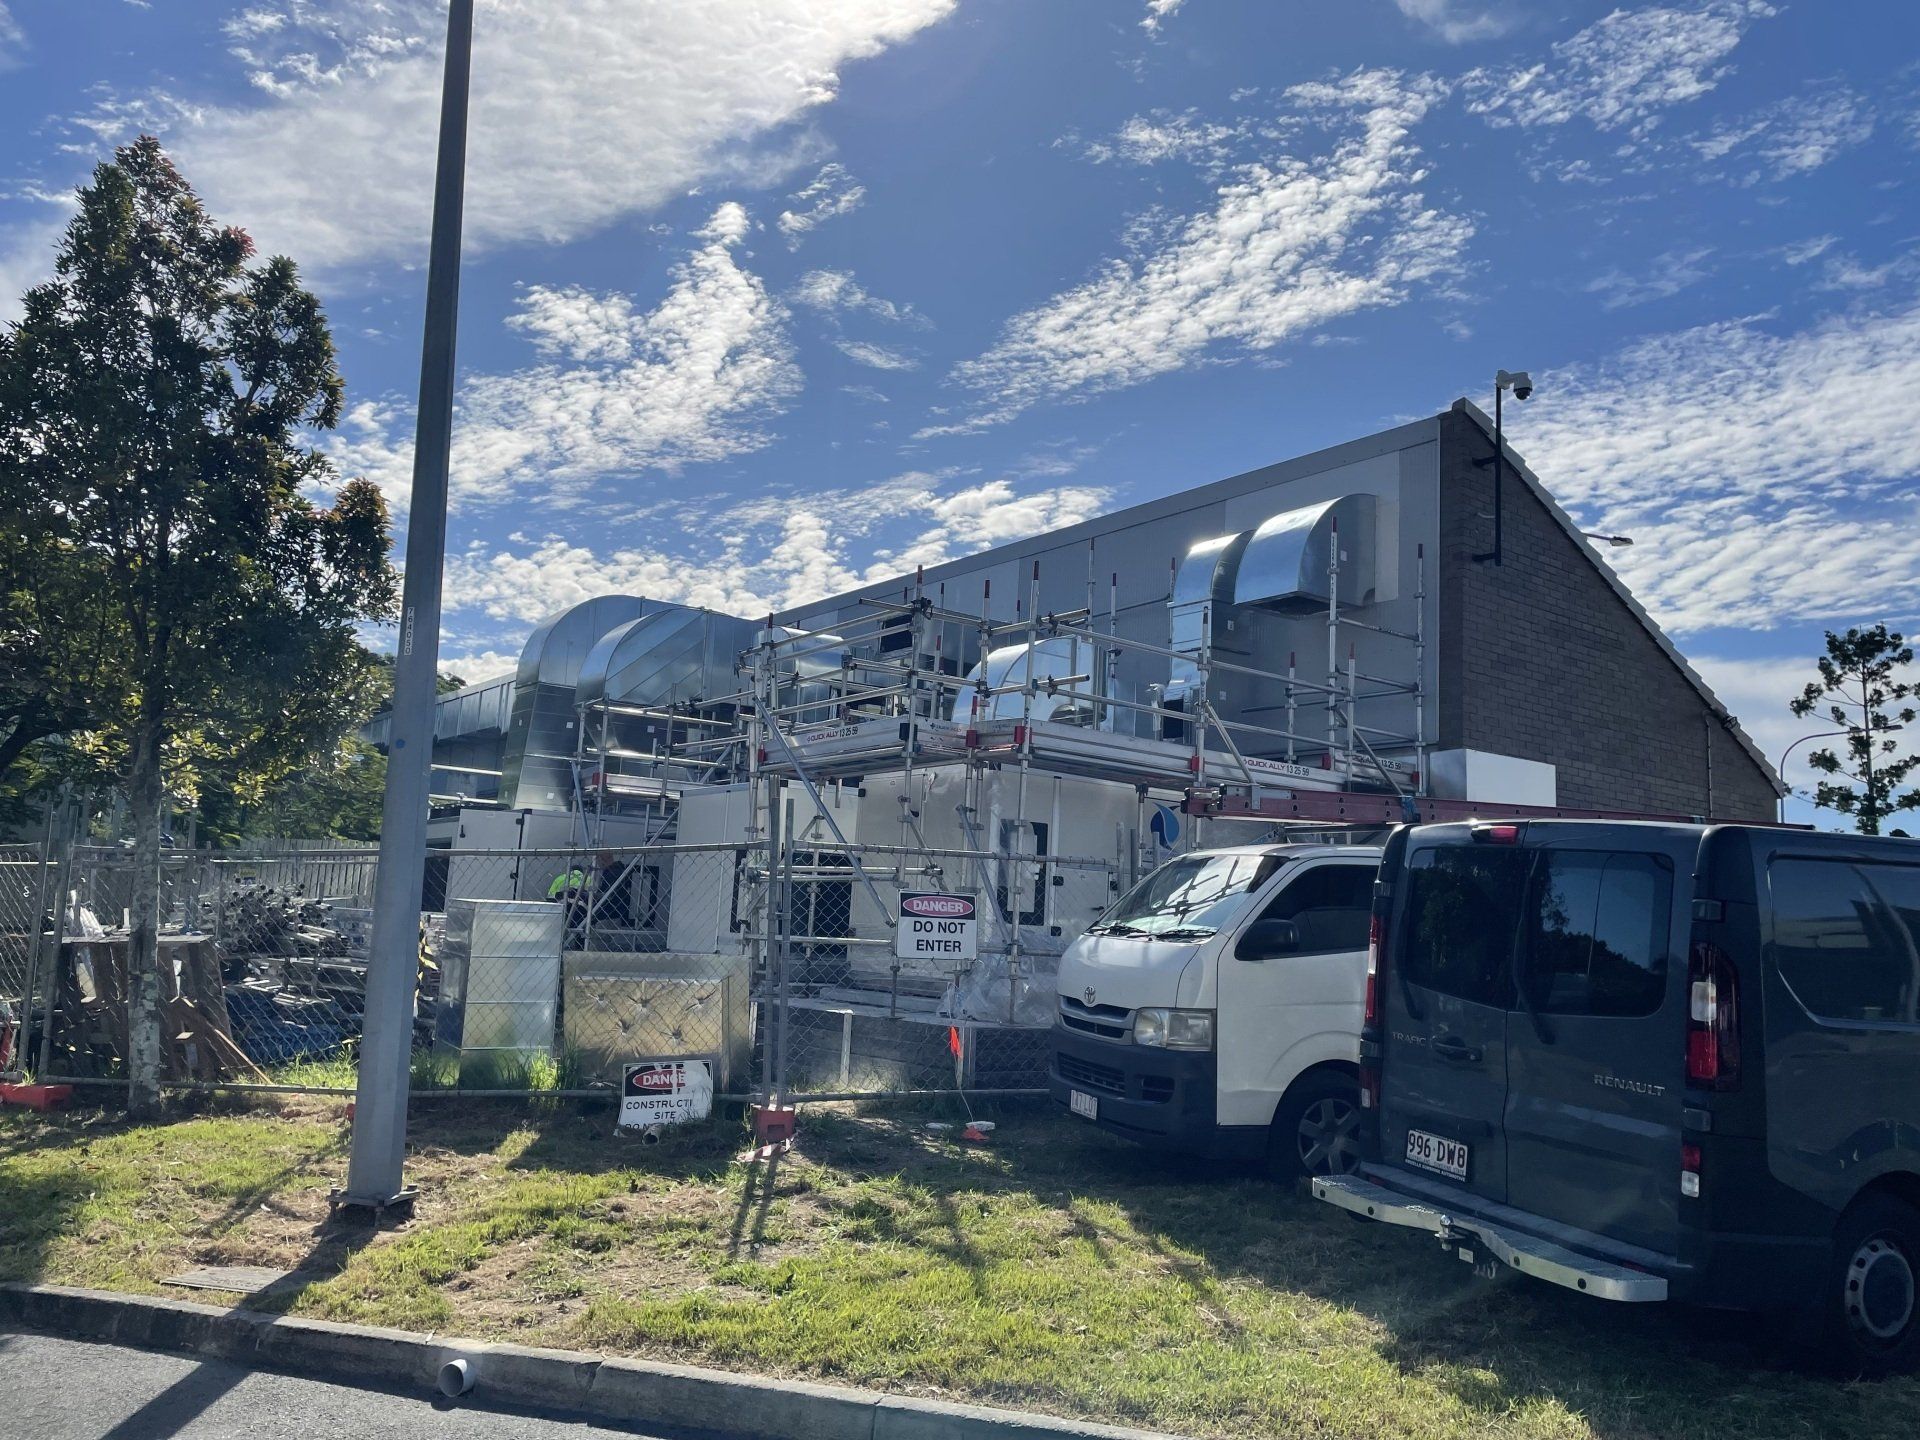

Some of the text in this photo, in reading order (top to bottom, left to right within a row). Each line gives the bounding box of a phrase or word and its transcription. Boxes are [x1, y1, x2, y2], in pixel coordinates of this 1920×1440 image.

[405, 607, 413, 654] 764050
[811, 733, 825, 742] QUICK
[826, 730, 839, 738] ALLY
[1248, 760, 1267, 768] QUICK
[1269, 763, 1285, 771] ALLY
[1287, 765, 1293, 774] 13
[1294, 767, 1301, 775] 25
[912, 899, 964, 913] DANGER
[913, 920, 966, 934] DO NOT
[916, 939, 962, 953] ENTER
[642, 1072, 687, 1086] DANGE
[1594, 1074, 1666, 1097] RENAULT
[625, 1098, 692, 1110] CONSTRUCTI
[653, 1111, 677, 1120] SITE
